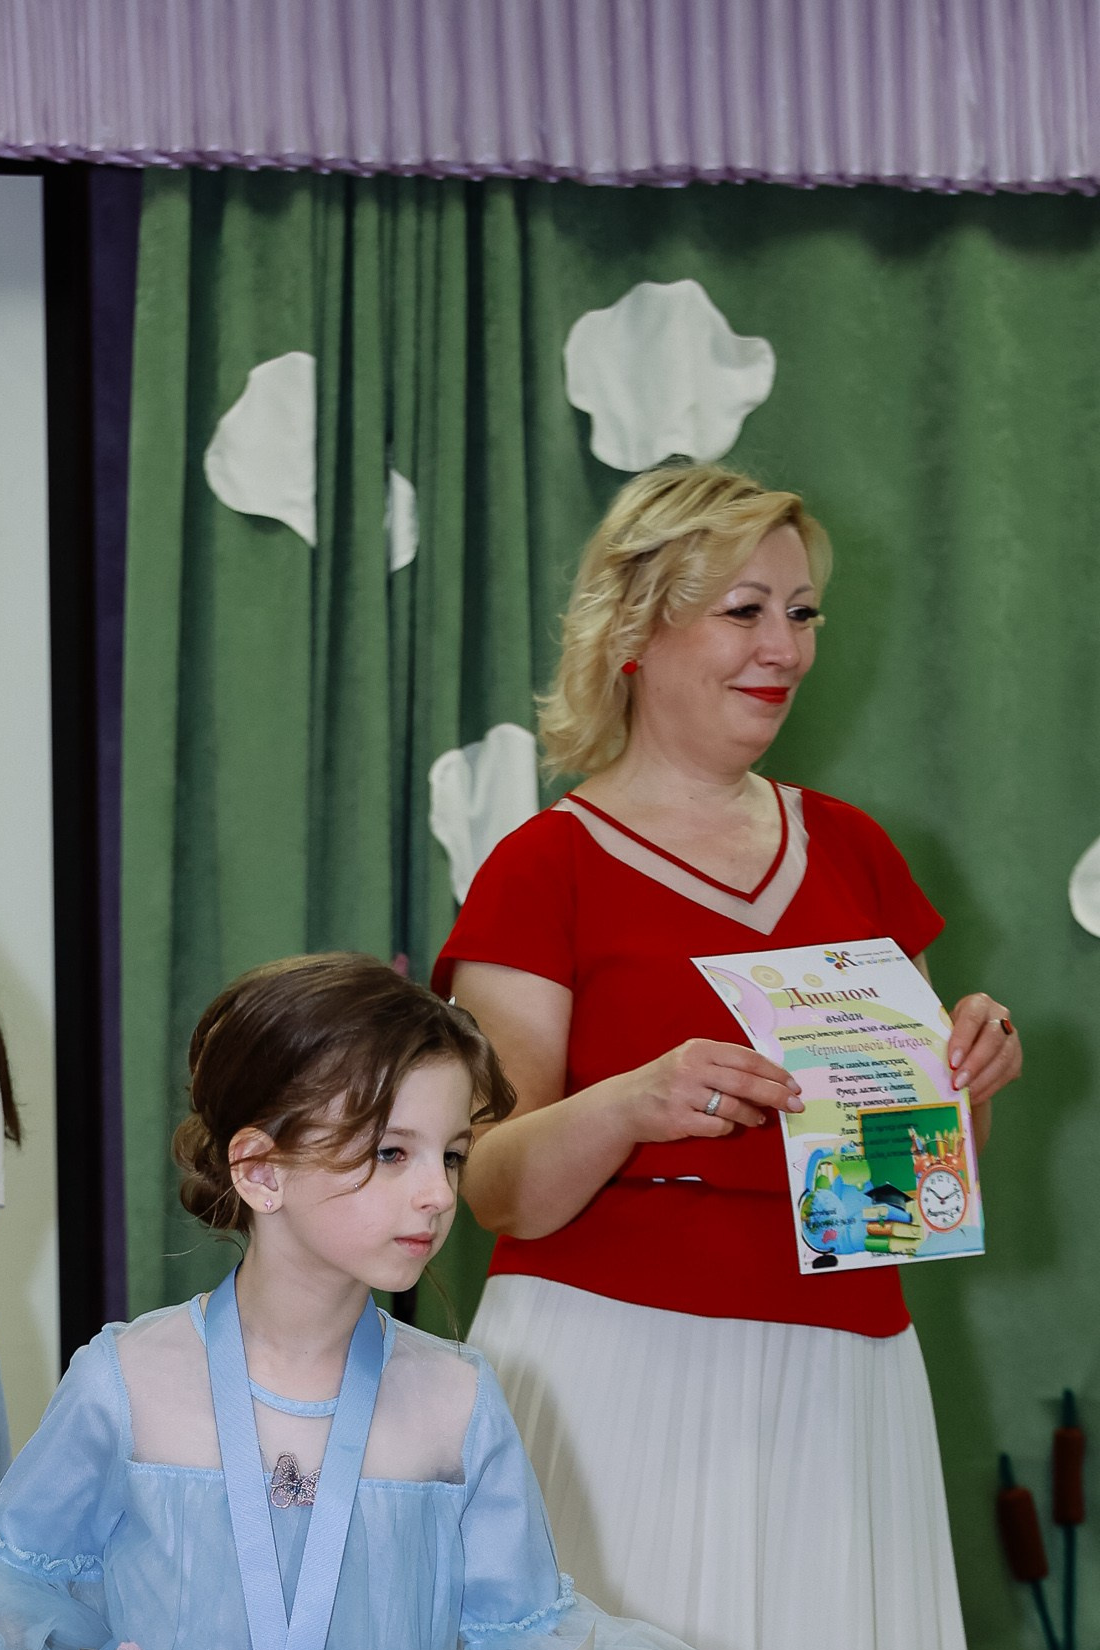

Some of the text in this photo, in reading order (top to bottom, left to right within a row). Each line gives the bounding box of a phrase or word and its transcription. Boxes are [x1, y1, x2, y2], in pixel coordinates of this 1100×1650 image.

[782, 987, 880, 1010] Диплом
[826, 1011, 864, 1024] выдан
[806, 1036, 932, 1059] Чернышовой Николь
